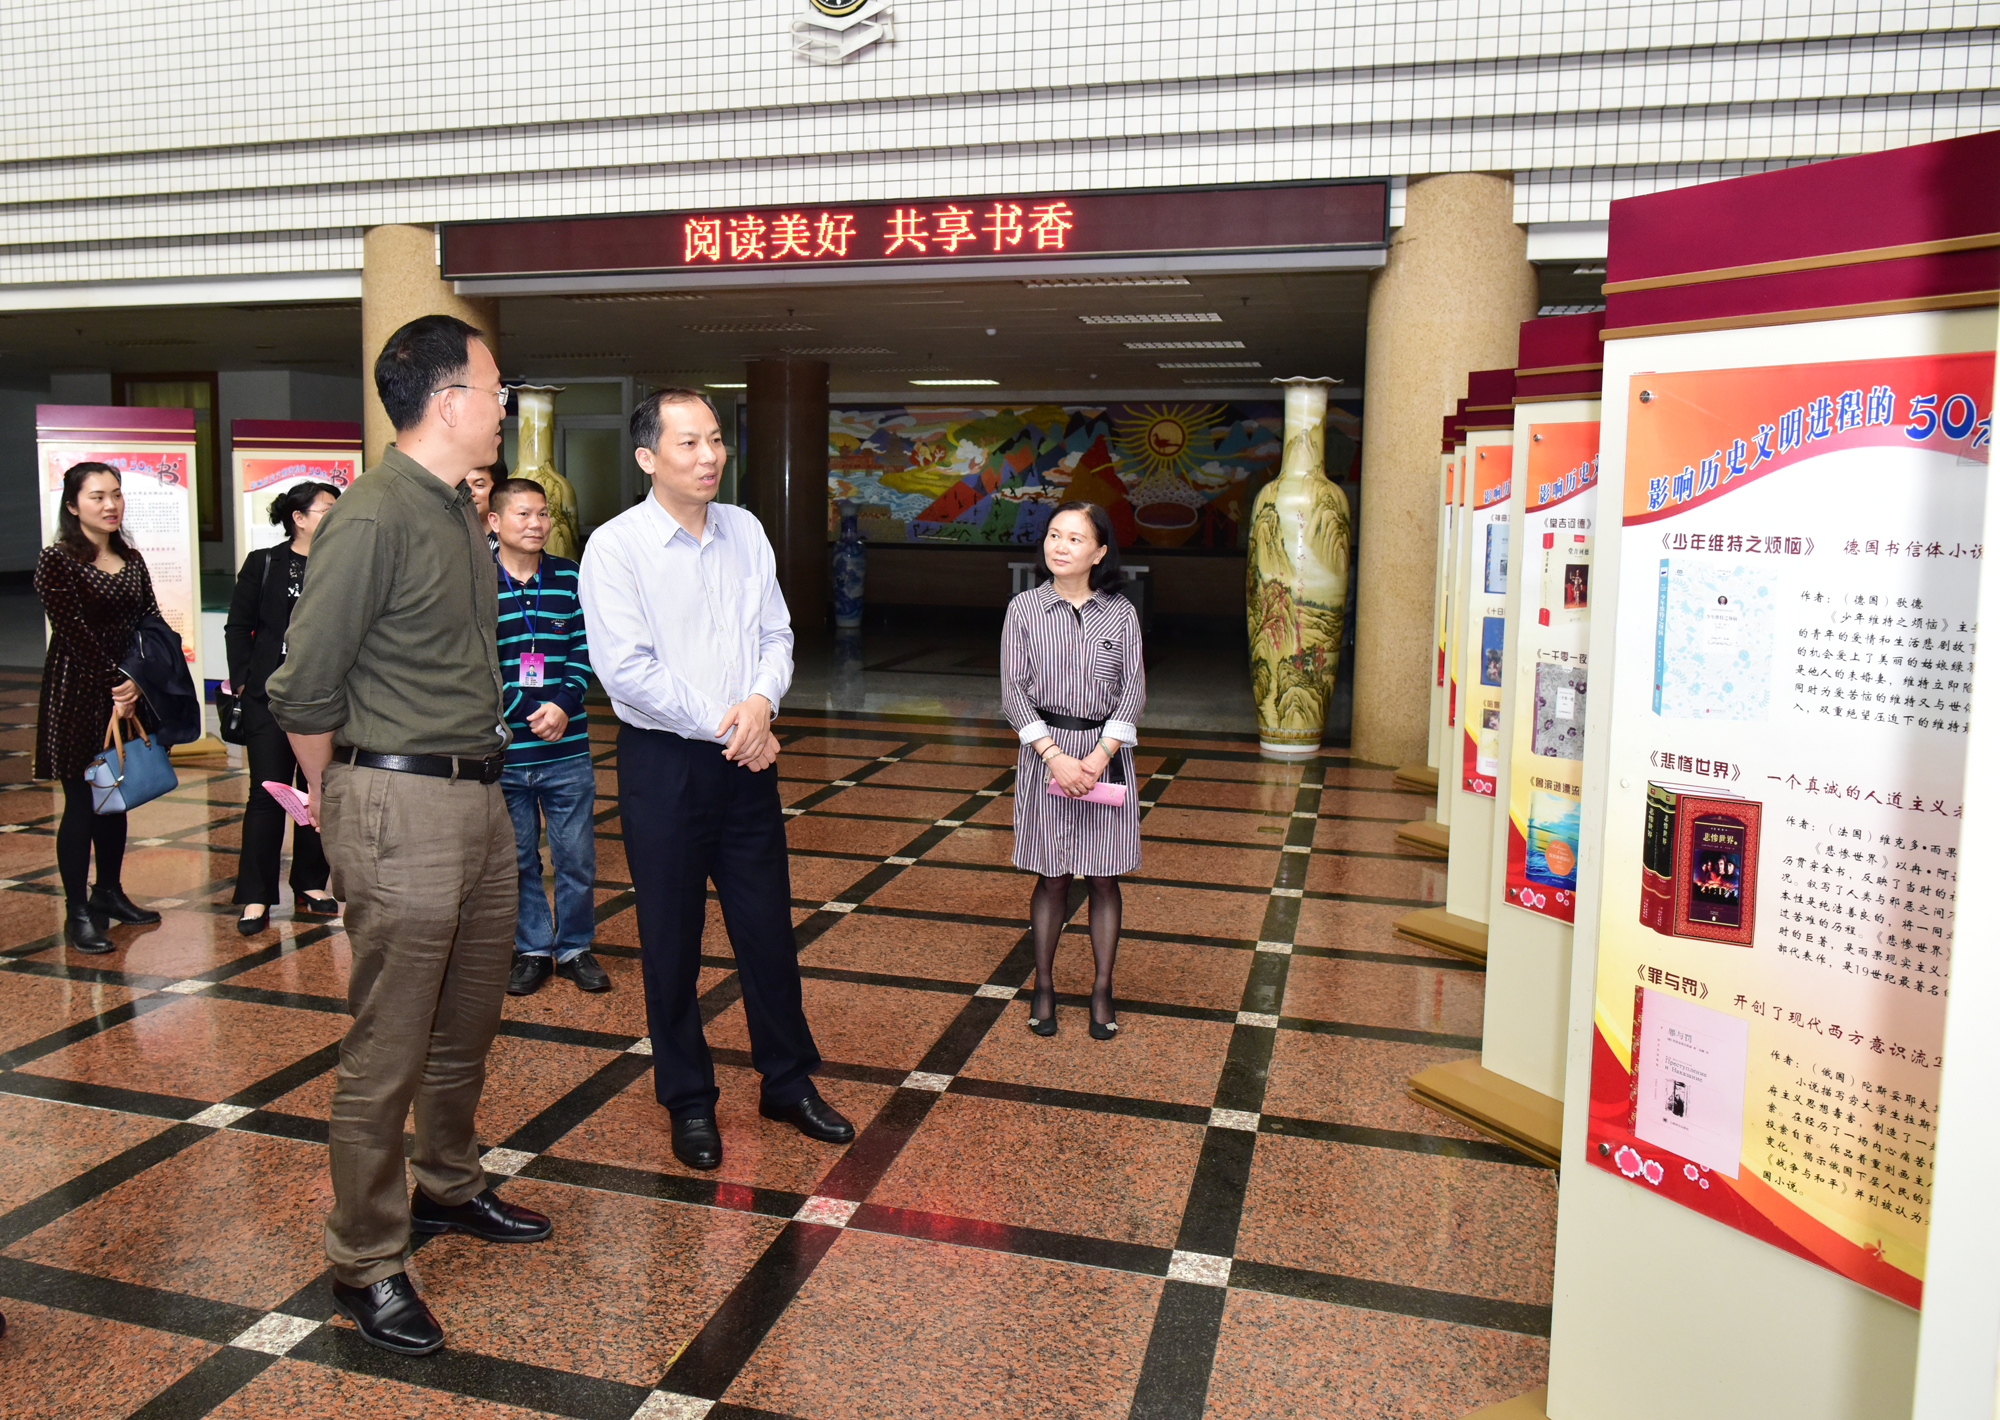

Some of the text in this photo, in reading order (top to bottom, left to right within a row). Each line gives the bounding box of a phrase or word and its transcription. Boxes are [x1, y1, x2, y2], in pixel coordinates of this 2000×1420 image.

[684, 202, 1074, 262] 阅读美好 共享书香
[1543, 518, 1592, 530] 《堂吉诃德》
[1661, 533, 1984, 559] 《少年维特之烦恼》 德国书信体小说
[1487, 607, 1505, 616] 《十日
[1650, 750, 1742, 782] 《悲惨世界》
[1637, 964, 1709, 1000] 《罪与罚》
[1796, 1077, 1937, 1132] 小说描写穷大学生拉斯
[1762, 1170, 1804, 1196] 国小说。
